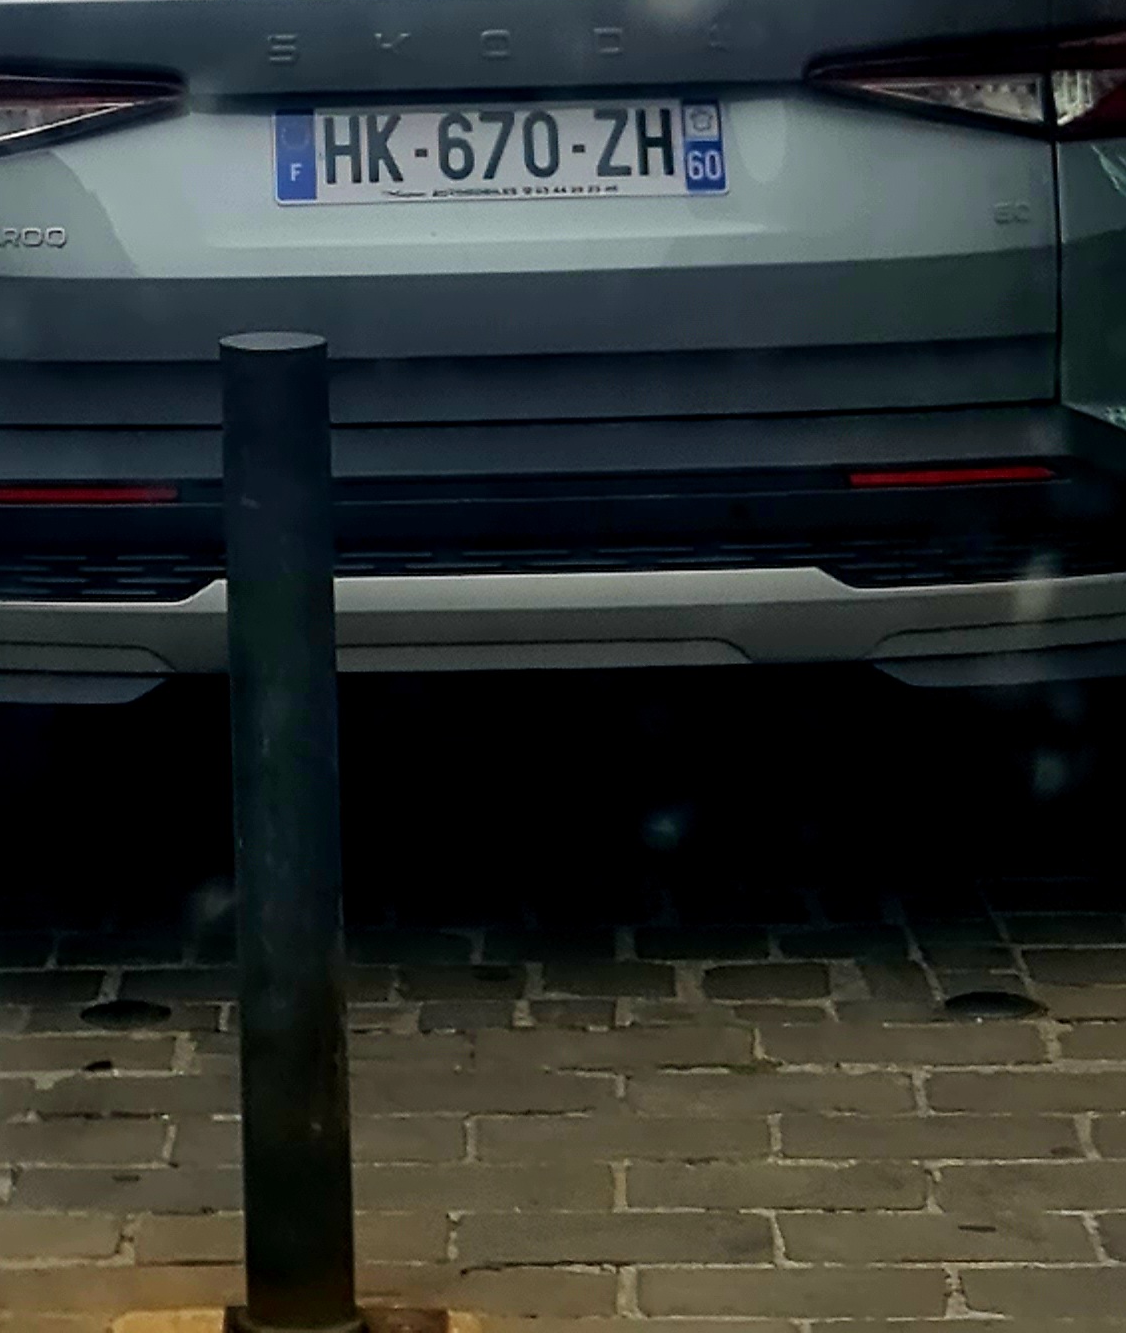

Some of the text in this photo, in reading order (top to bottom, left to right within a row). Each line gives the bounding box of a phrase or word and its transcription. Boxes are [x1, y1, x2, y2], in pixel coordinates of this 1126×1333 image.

[289, 108, 723, 185] F HK-670-ZH 60
